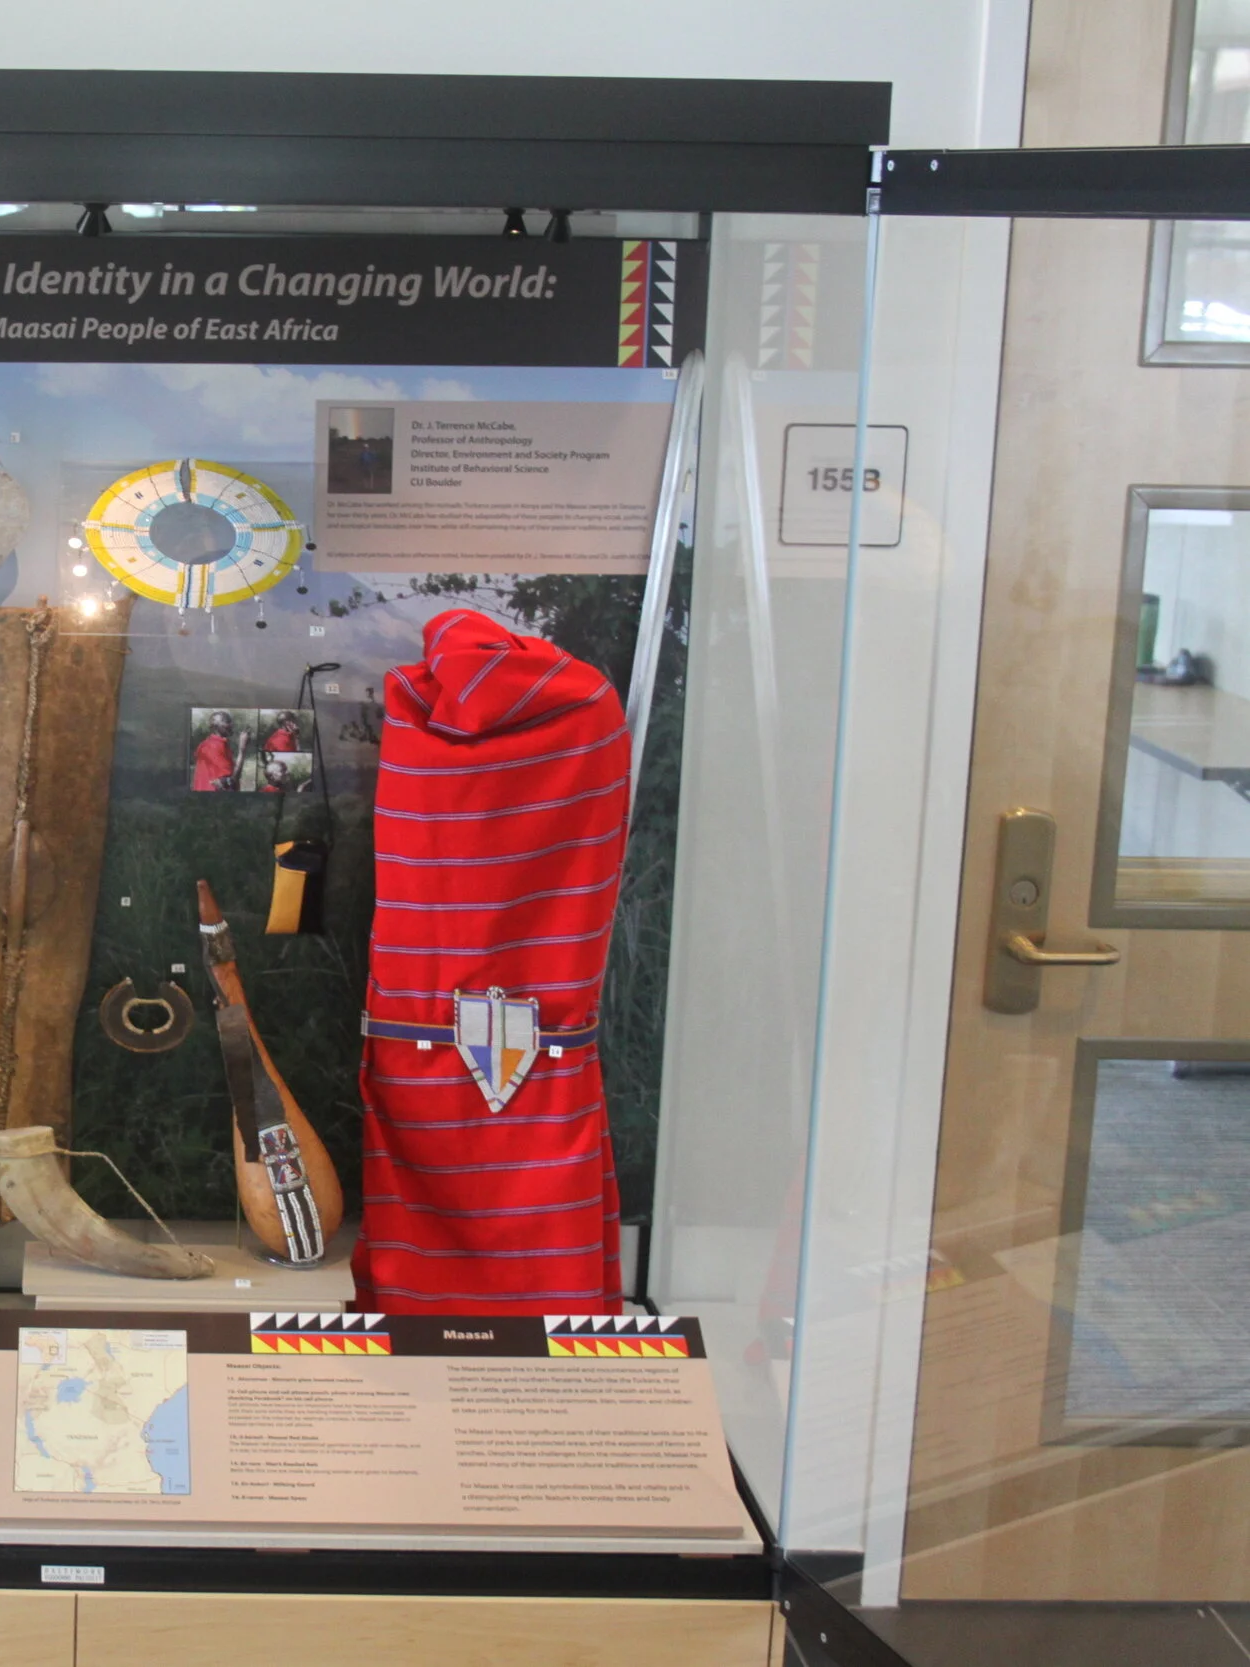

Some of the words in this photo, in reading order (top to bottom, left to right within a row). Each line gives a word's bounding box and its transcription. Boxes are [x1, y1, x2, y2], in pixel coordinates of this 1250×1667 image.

[4, 263, 151, 303] Identity
[160, 263, 195, 295] in
[205, 270, 229, 296] a
[238, 264, 422, 305] Changing
[431, 266, 557, 298] World:
[82, 318, 167, 345] People
[173, 319, 199, 340] of
[205, 319, 258, 341] East
[264, 320, 338, 341] Africa
[411, 436, 453, 444] Professor
[456, 436, 466, 444] of
[468, 436, 532, 447] Anthropology
[411, 450, 450, 461] Director,
[452, 450, 512, 459] Environment
[514, 450, 531, 459] and
[534, 451, 567, 461] Society
[569, 451, 609, 461] Program
[411, 464, 449, 472] Institute
[451, 464, 460, 473] of
[463, 464, 512, 473] Behavioral
[514, 464, 549, 473] Science
[411, 478, 423, 486] CU
[425, 478, 462, 486] Boulder
[807, 467, 881, 492] 155B
[444, 1330, 494, 1339] Maasai
